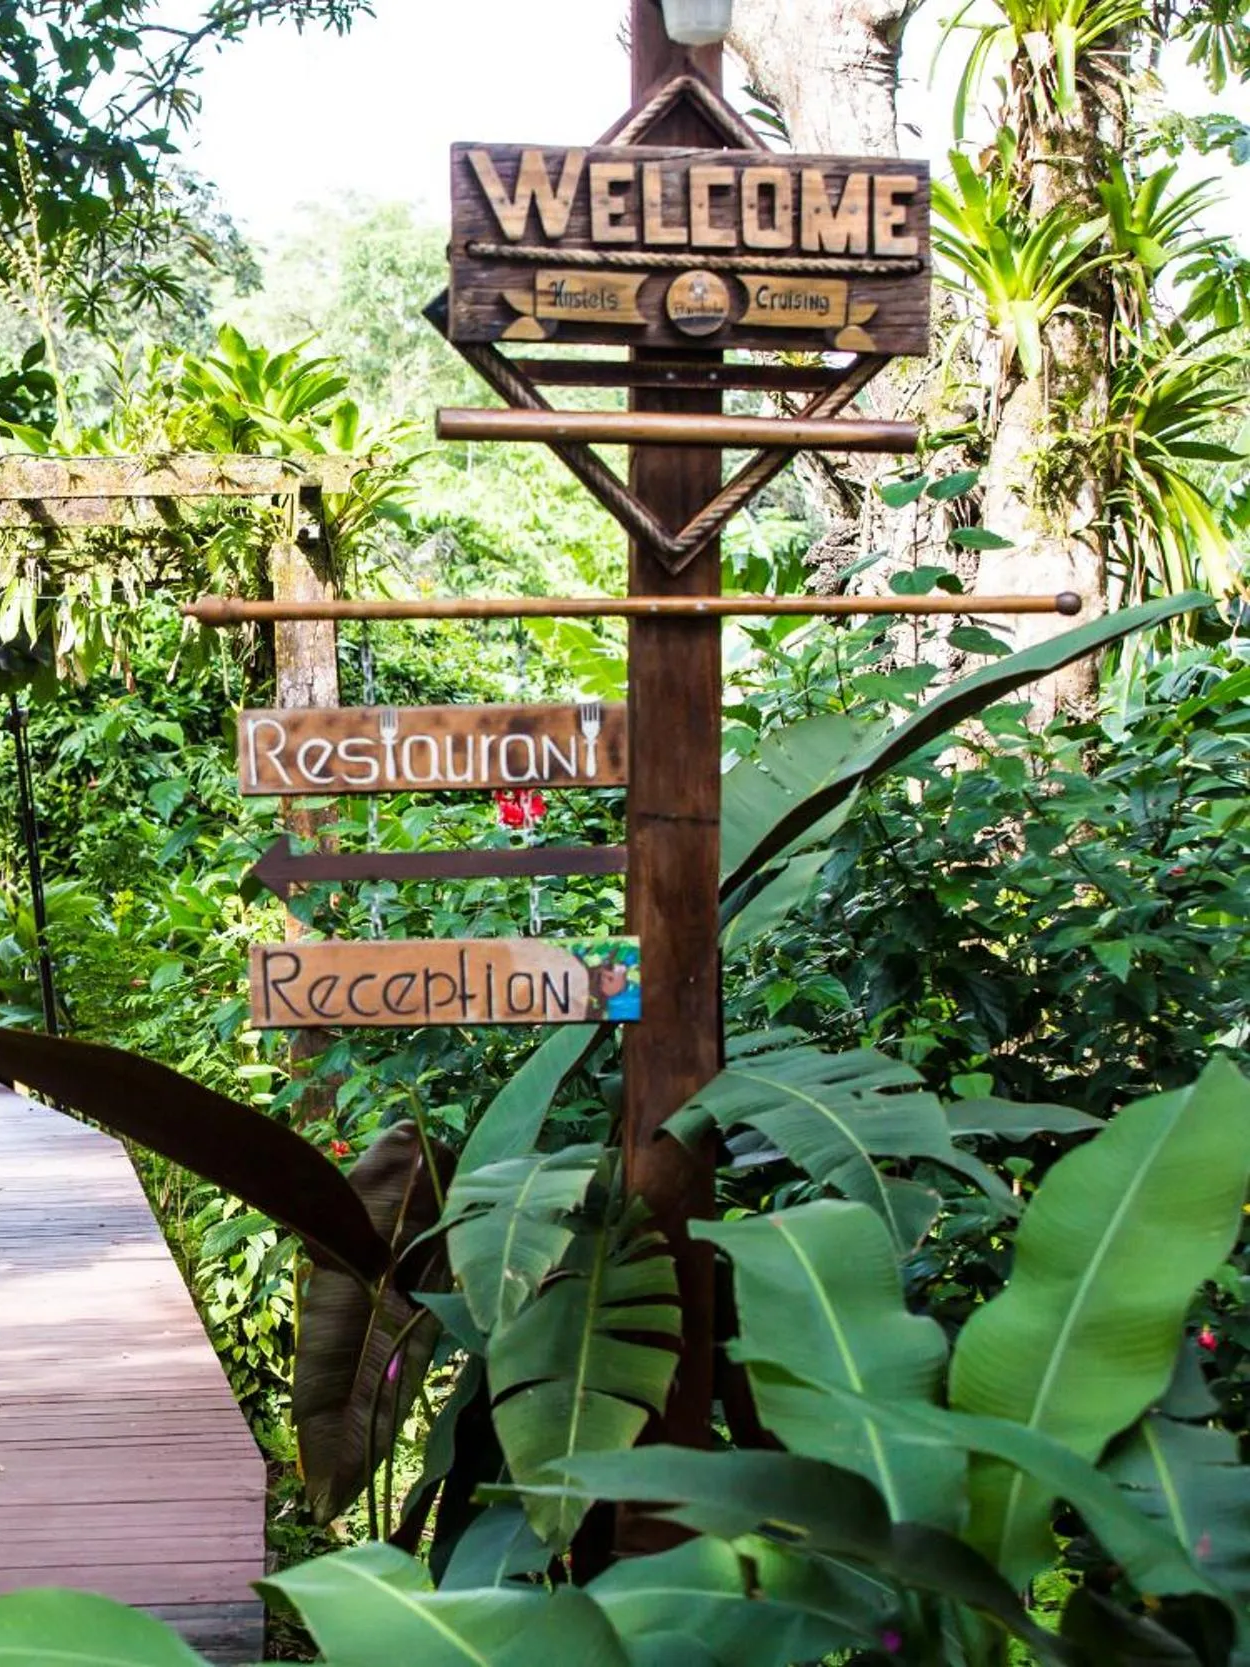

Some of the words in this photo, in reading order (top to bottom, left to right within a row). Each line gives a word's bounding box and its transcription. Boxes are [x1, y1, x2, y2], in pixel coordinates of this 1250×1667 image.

[467, 149, 920, 256] WELCOME
[247, 702, 602, 786] Restaurant
[261, 949, 570, 1021] Reception
